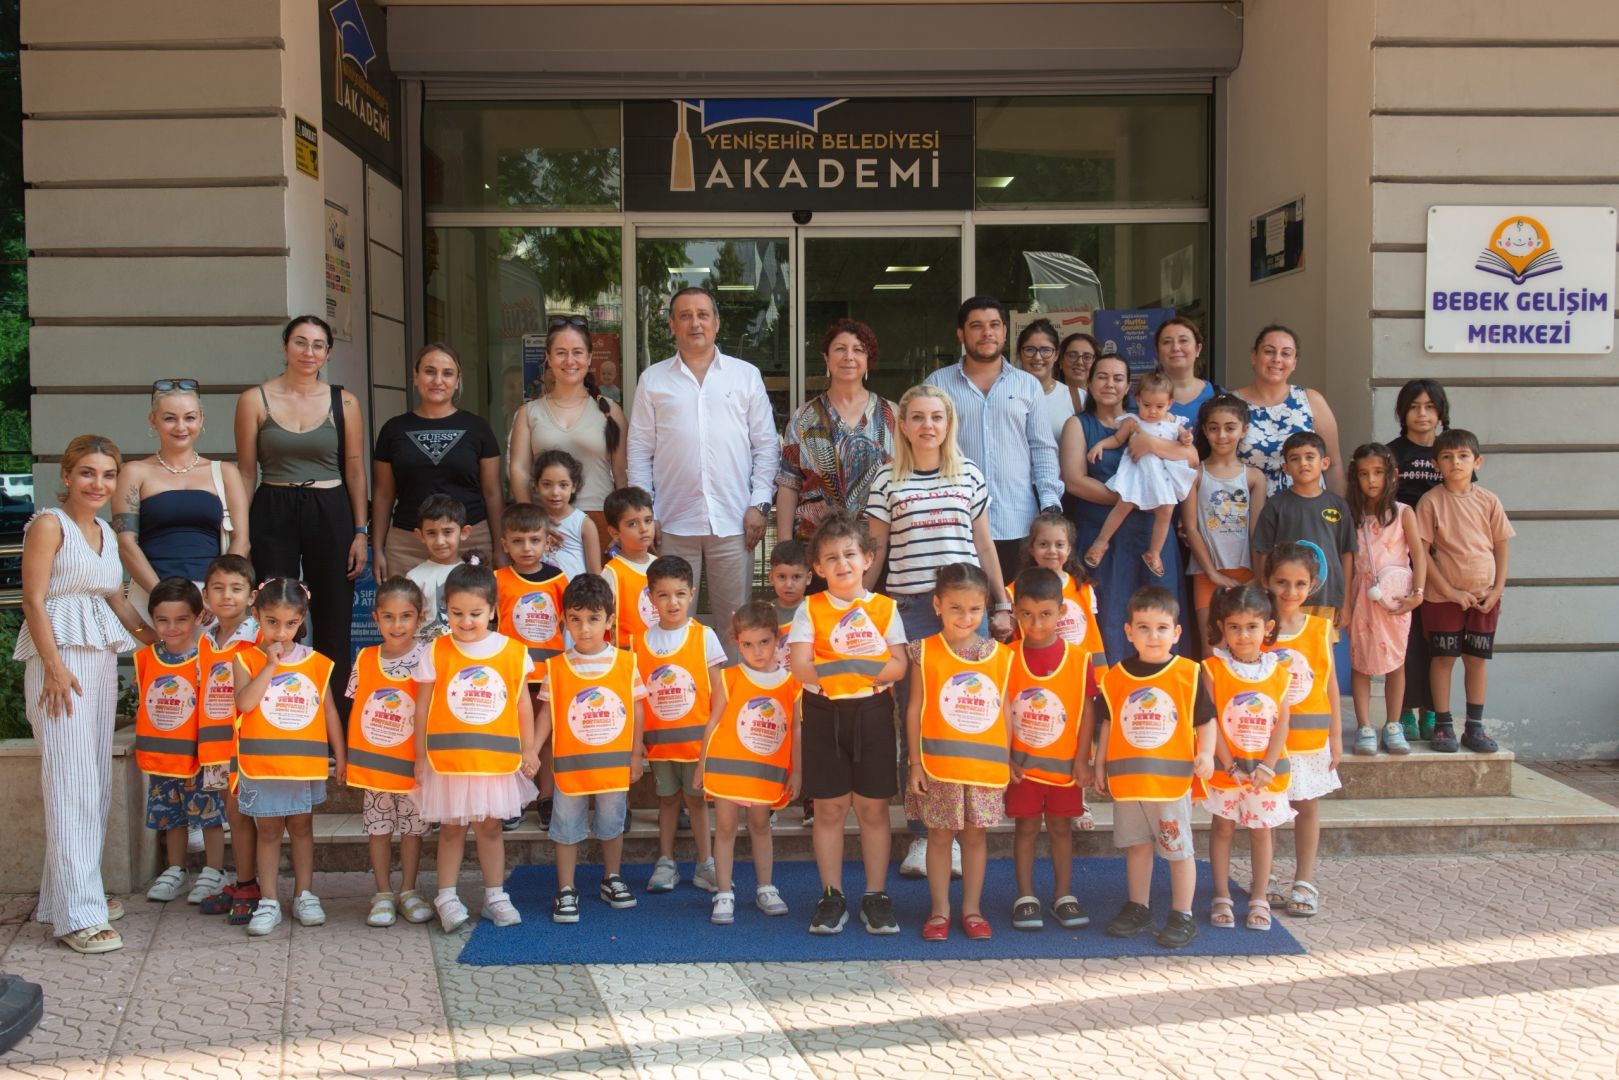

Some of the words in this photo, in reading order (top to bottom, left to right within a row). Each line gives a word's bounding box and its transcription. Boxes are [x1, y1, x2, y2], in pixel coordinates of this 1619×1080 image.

[344, 83, 390, 142] AKADEMİ
[705, 131, 815, 154] YENİŞEHİR
[822, 131, 940, 150] BELEDİYESİ
[704, 150, 940, 189] AKADEMİ
[1432, 291, 1509, 311] BEBEK
[1516, 287, 1608, 316] GELİŞİM
[1468, 320, 1571, 344] MERKEZİ
[417, 433, 453, 441] GUESS
[1414, 459, 1434, 469] STA
[361, 598, 376, 606] ATI
[1432, 635, 1458, 650] CAPE
